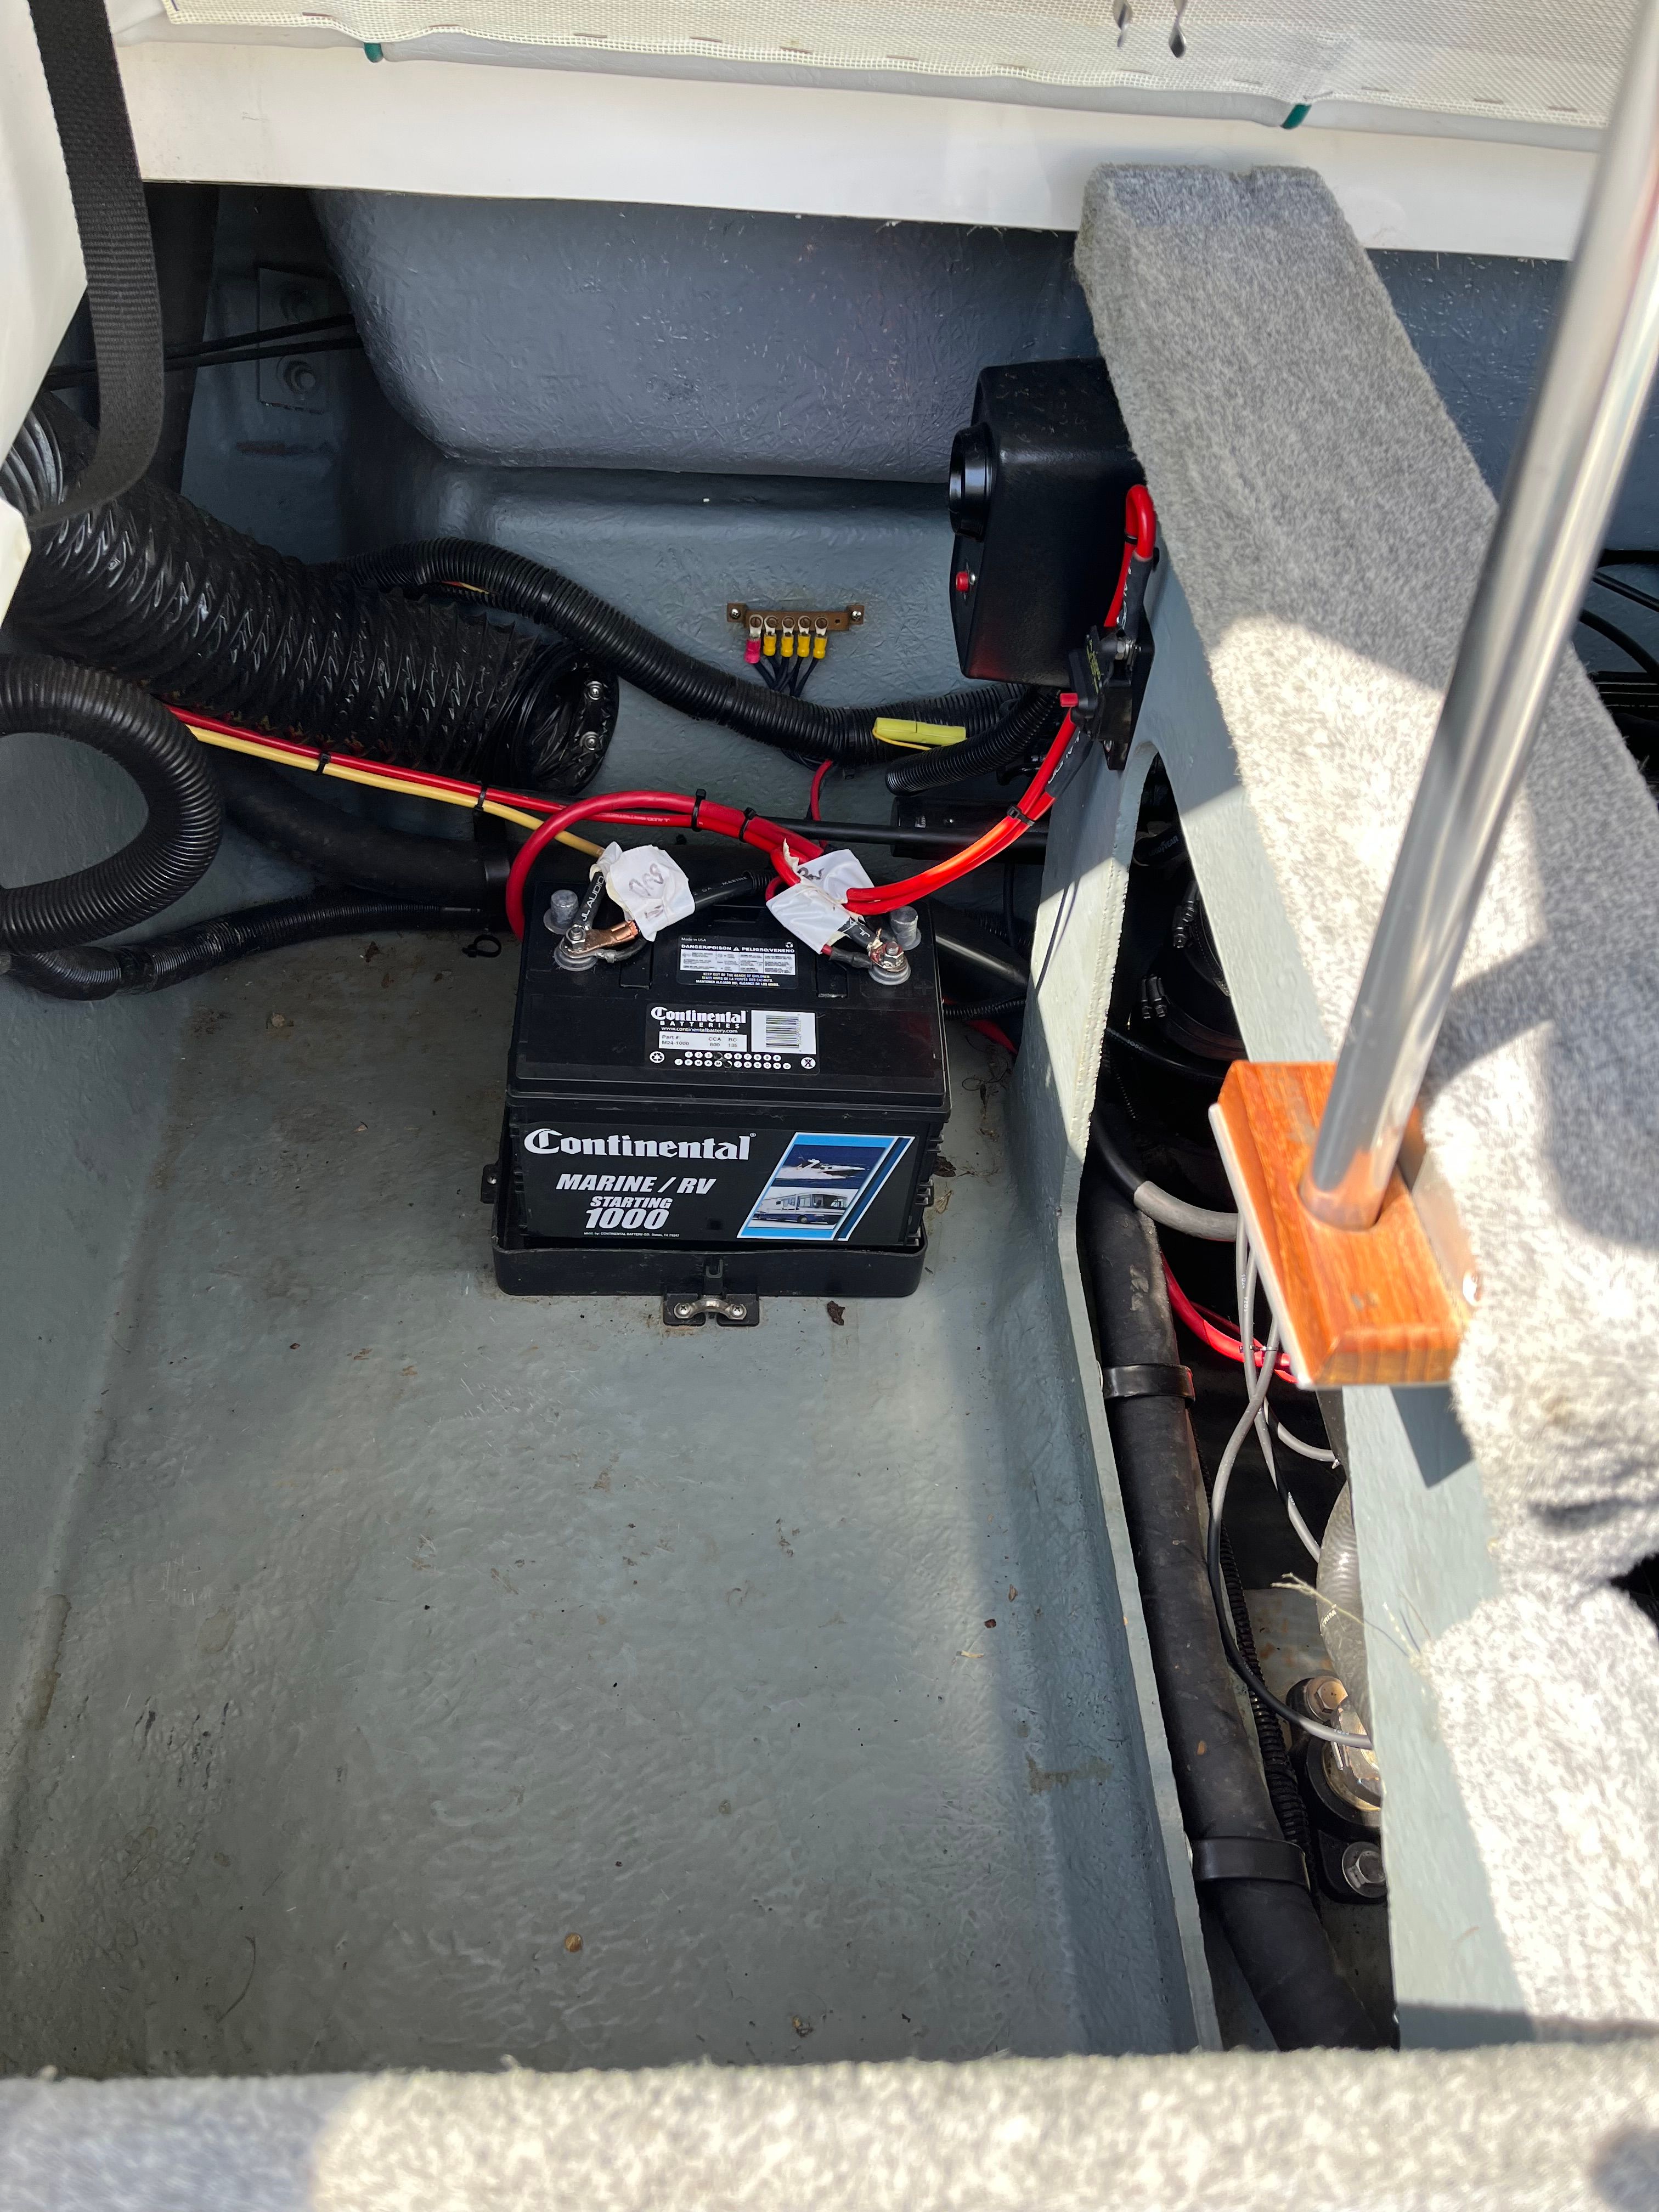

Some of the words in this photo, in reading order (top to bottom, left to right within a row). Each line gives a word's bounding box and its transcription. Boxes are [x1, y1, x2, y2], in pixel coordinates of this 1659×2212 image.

[581, 910, 590, 922] JL
[586, 875, 604, 909] AUDIO
[651, 1006, 746, 1024] Continental
[659, 1020, 740, 1029] BATTERIES
[523, 1128, 751, 1160] Continental
[555, 1173, 658, 1193] MARINE
[657, 1177, 676, 1193] /
[676, 1177, 716, 1194] RV
[590, 1195, 673, 1209] STARTING
[585, 1208, 669, 1230] 1000
